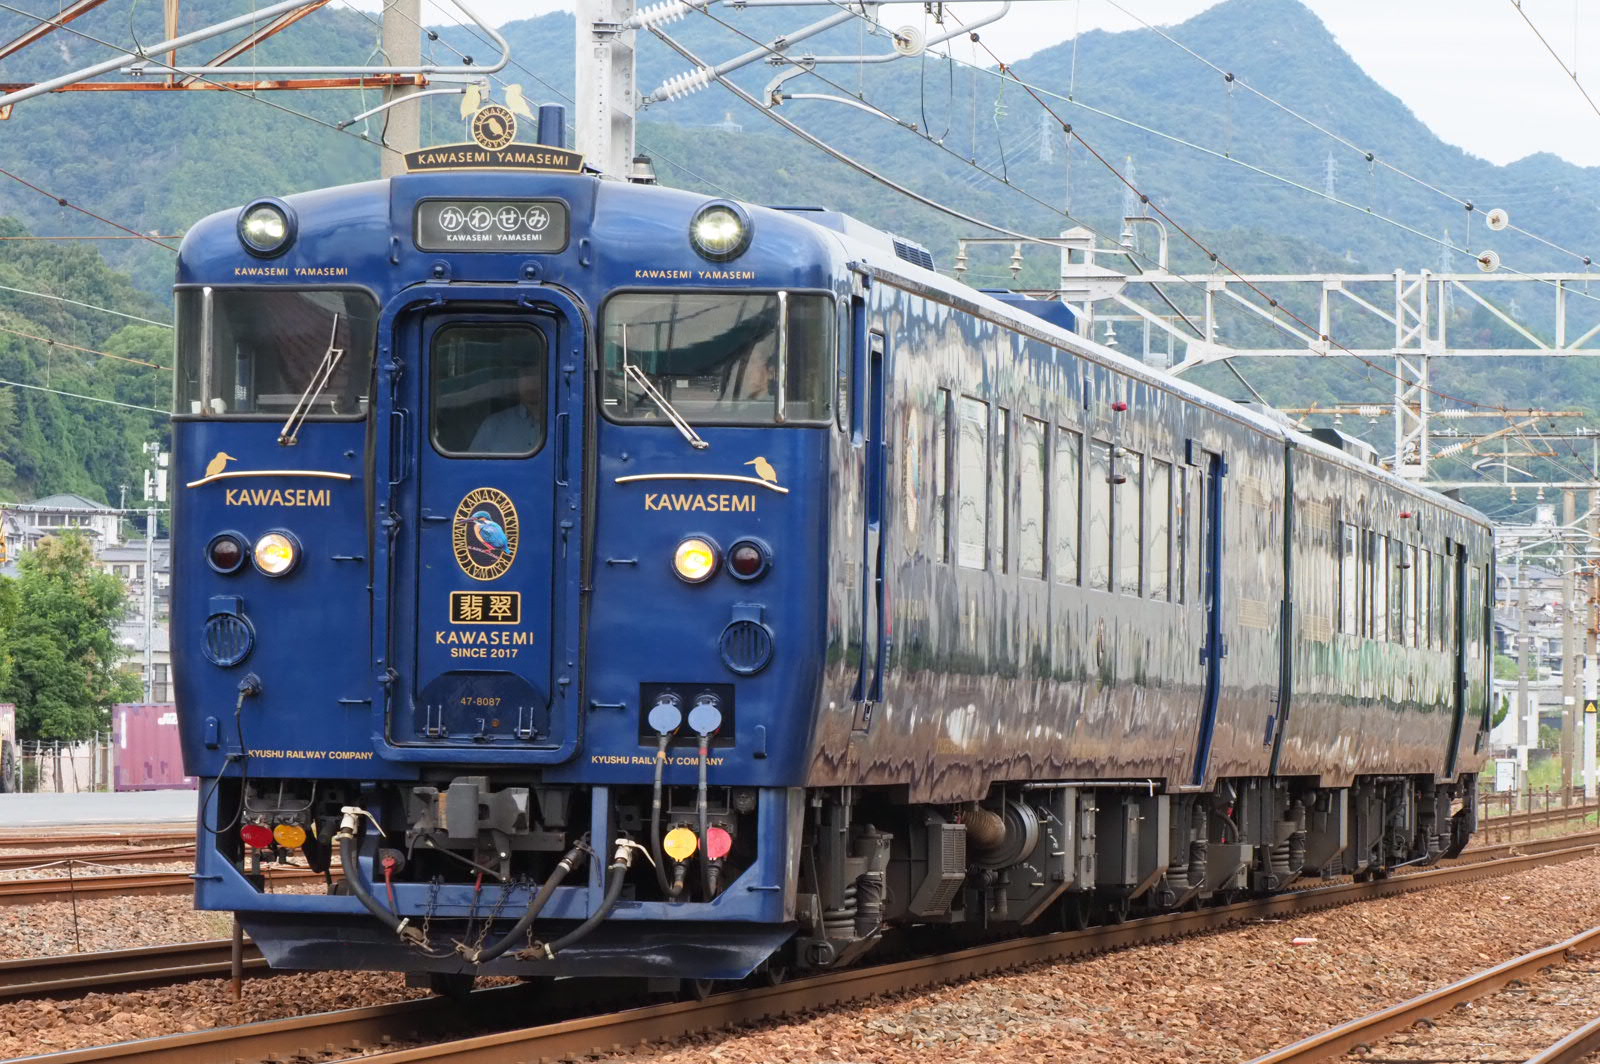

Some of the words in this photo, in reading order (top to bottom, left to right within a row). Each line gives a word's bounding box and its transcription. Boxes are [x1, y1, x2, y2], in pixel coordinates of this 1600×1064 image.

[418, 152, 490, 165] KAWASEMI
[497, 152, 569, 166] YAMASEMI
[439, 206, 550, 231] かわせみ
[497, 233, 542, 241] YAMASEMI
[234, 267, 289, 276] KAWASEMI
[294, 267, 349, 276] YAMASEMI
[635, 269, 692, 279] KAWASEMI
[698, 270, 755, 280] YAMASEMI
[225, 489, 331, 507] KAWASEMI
[645, 493, 756, 512] KAWASEMI
[460, 595, 512, 621] 翡翠
[436, 631, 535, 645] KAWASEMI
[451, 648, 487, 658] SINCE
[490, 649, 519, 658] 2017
[460, 697, 501, 706] 47-8087
[248, 749, 284, 758] KYUSHU
[286, 750, 326, 759] RAILWAY
[328, 751, 373, 760] COMPANY
[591, 755, 629, 764] KYUSHU
[676, 757, 723, 766] COMANY
